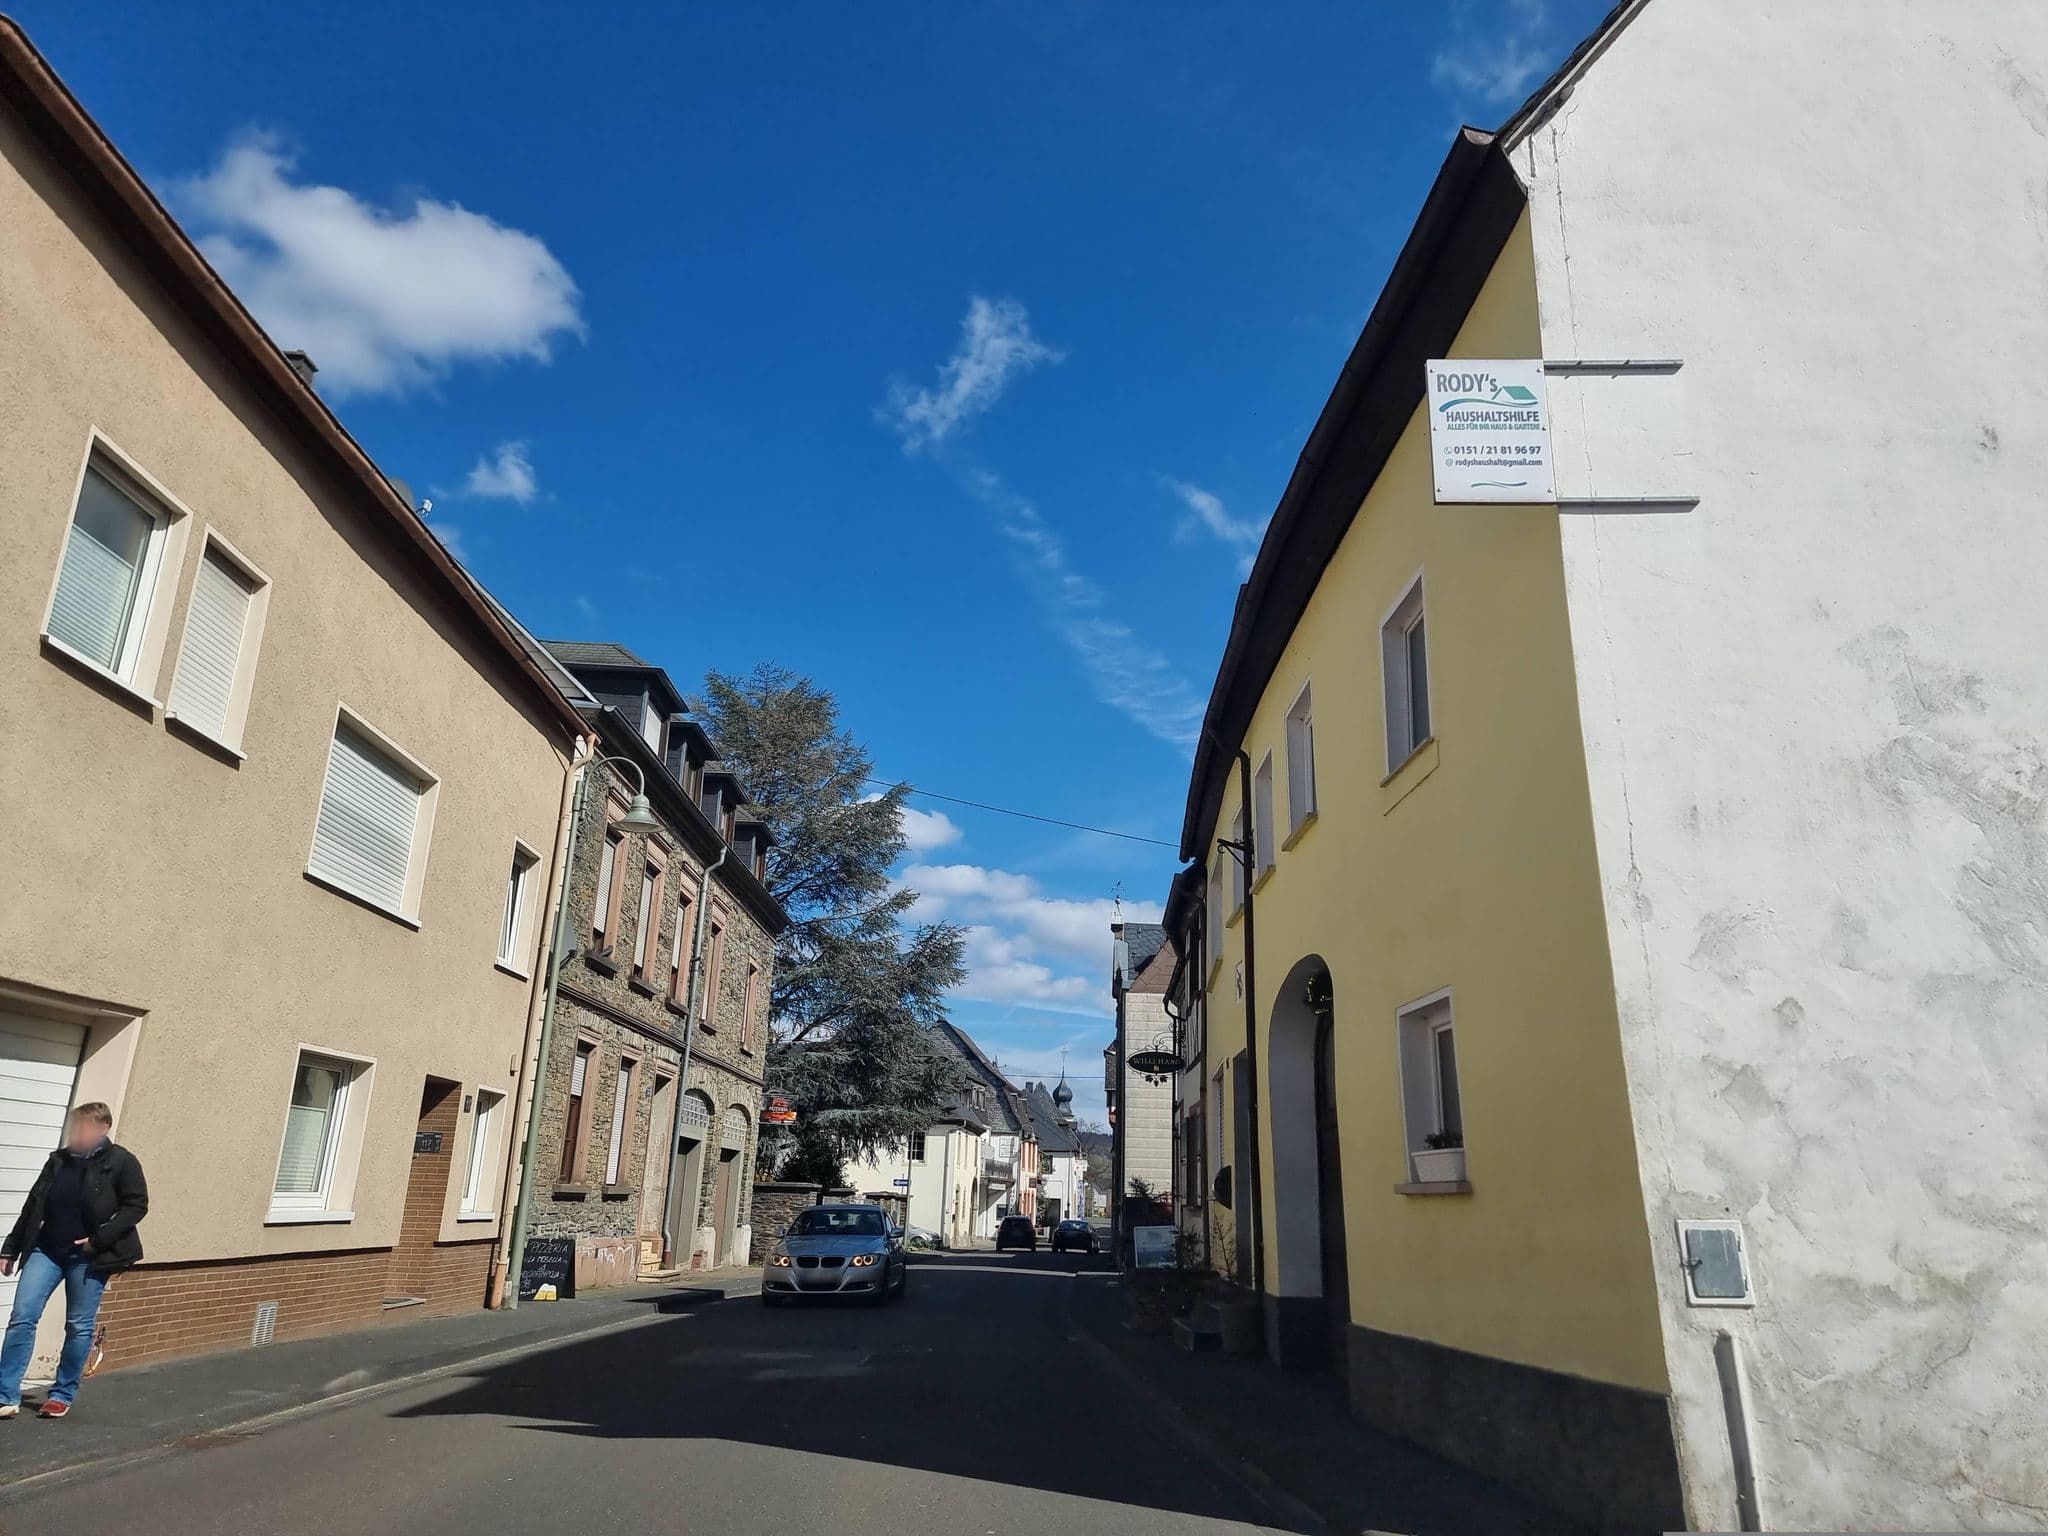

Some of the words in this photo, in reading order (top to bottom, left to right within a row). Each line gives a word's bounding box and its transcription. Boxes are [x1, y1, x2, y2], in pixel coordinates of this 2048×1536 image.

[1436, 373, 1498, 393] RODY's
[1446, 411, 1540, 422] HAUSHALTSHILFE
[1447, 423, 1465, 431] ALLES
[1467, 422, 1478, 431] FÜR
[1491, 423, 1507, 431] HAUS
[1453, 445, 1478, 455] 0151
[1486, 445, 1498, 455] 21
[1500, 445, 1512, 455] 81
[1514, 445, 1528, 455] 96
[1529, 445, 1541, 455] 97
